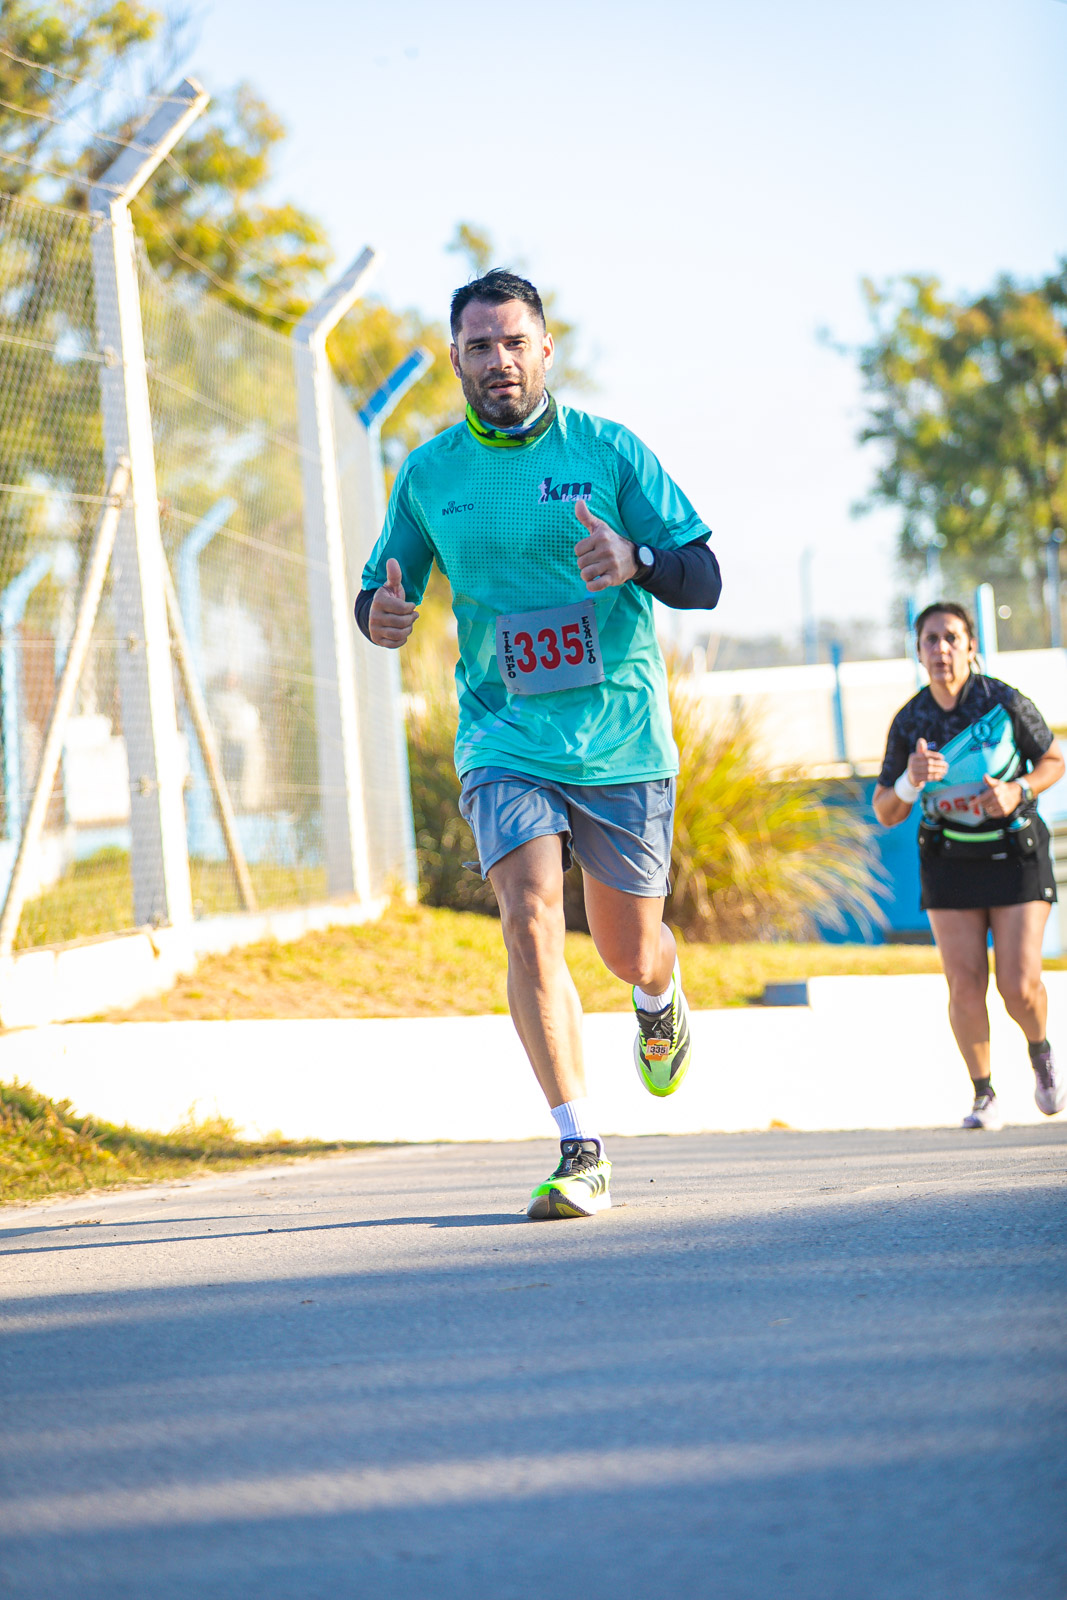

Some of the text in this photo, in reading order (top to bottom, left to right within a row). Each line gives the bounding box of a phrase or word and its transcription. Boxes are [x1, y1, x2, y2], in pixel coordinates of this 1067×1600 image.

[541, 477, 592, 502] km
[442, 503, 474, 516] INVICTO
[502, 631, 516, 678] TIEMPO
[514, 622, 584, 673] 335
[581, 616, 596, 664] EXACTO
[650, 1046, 666, 1054] 335
